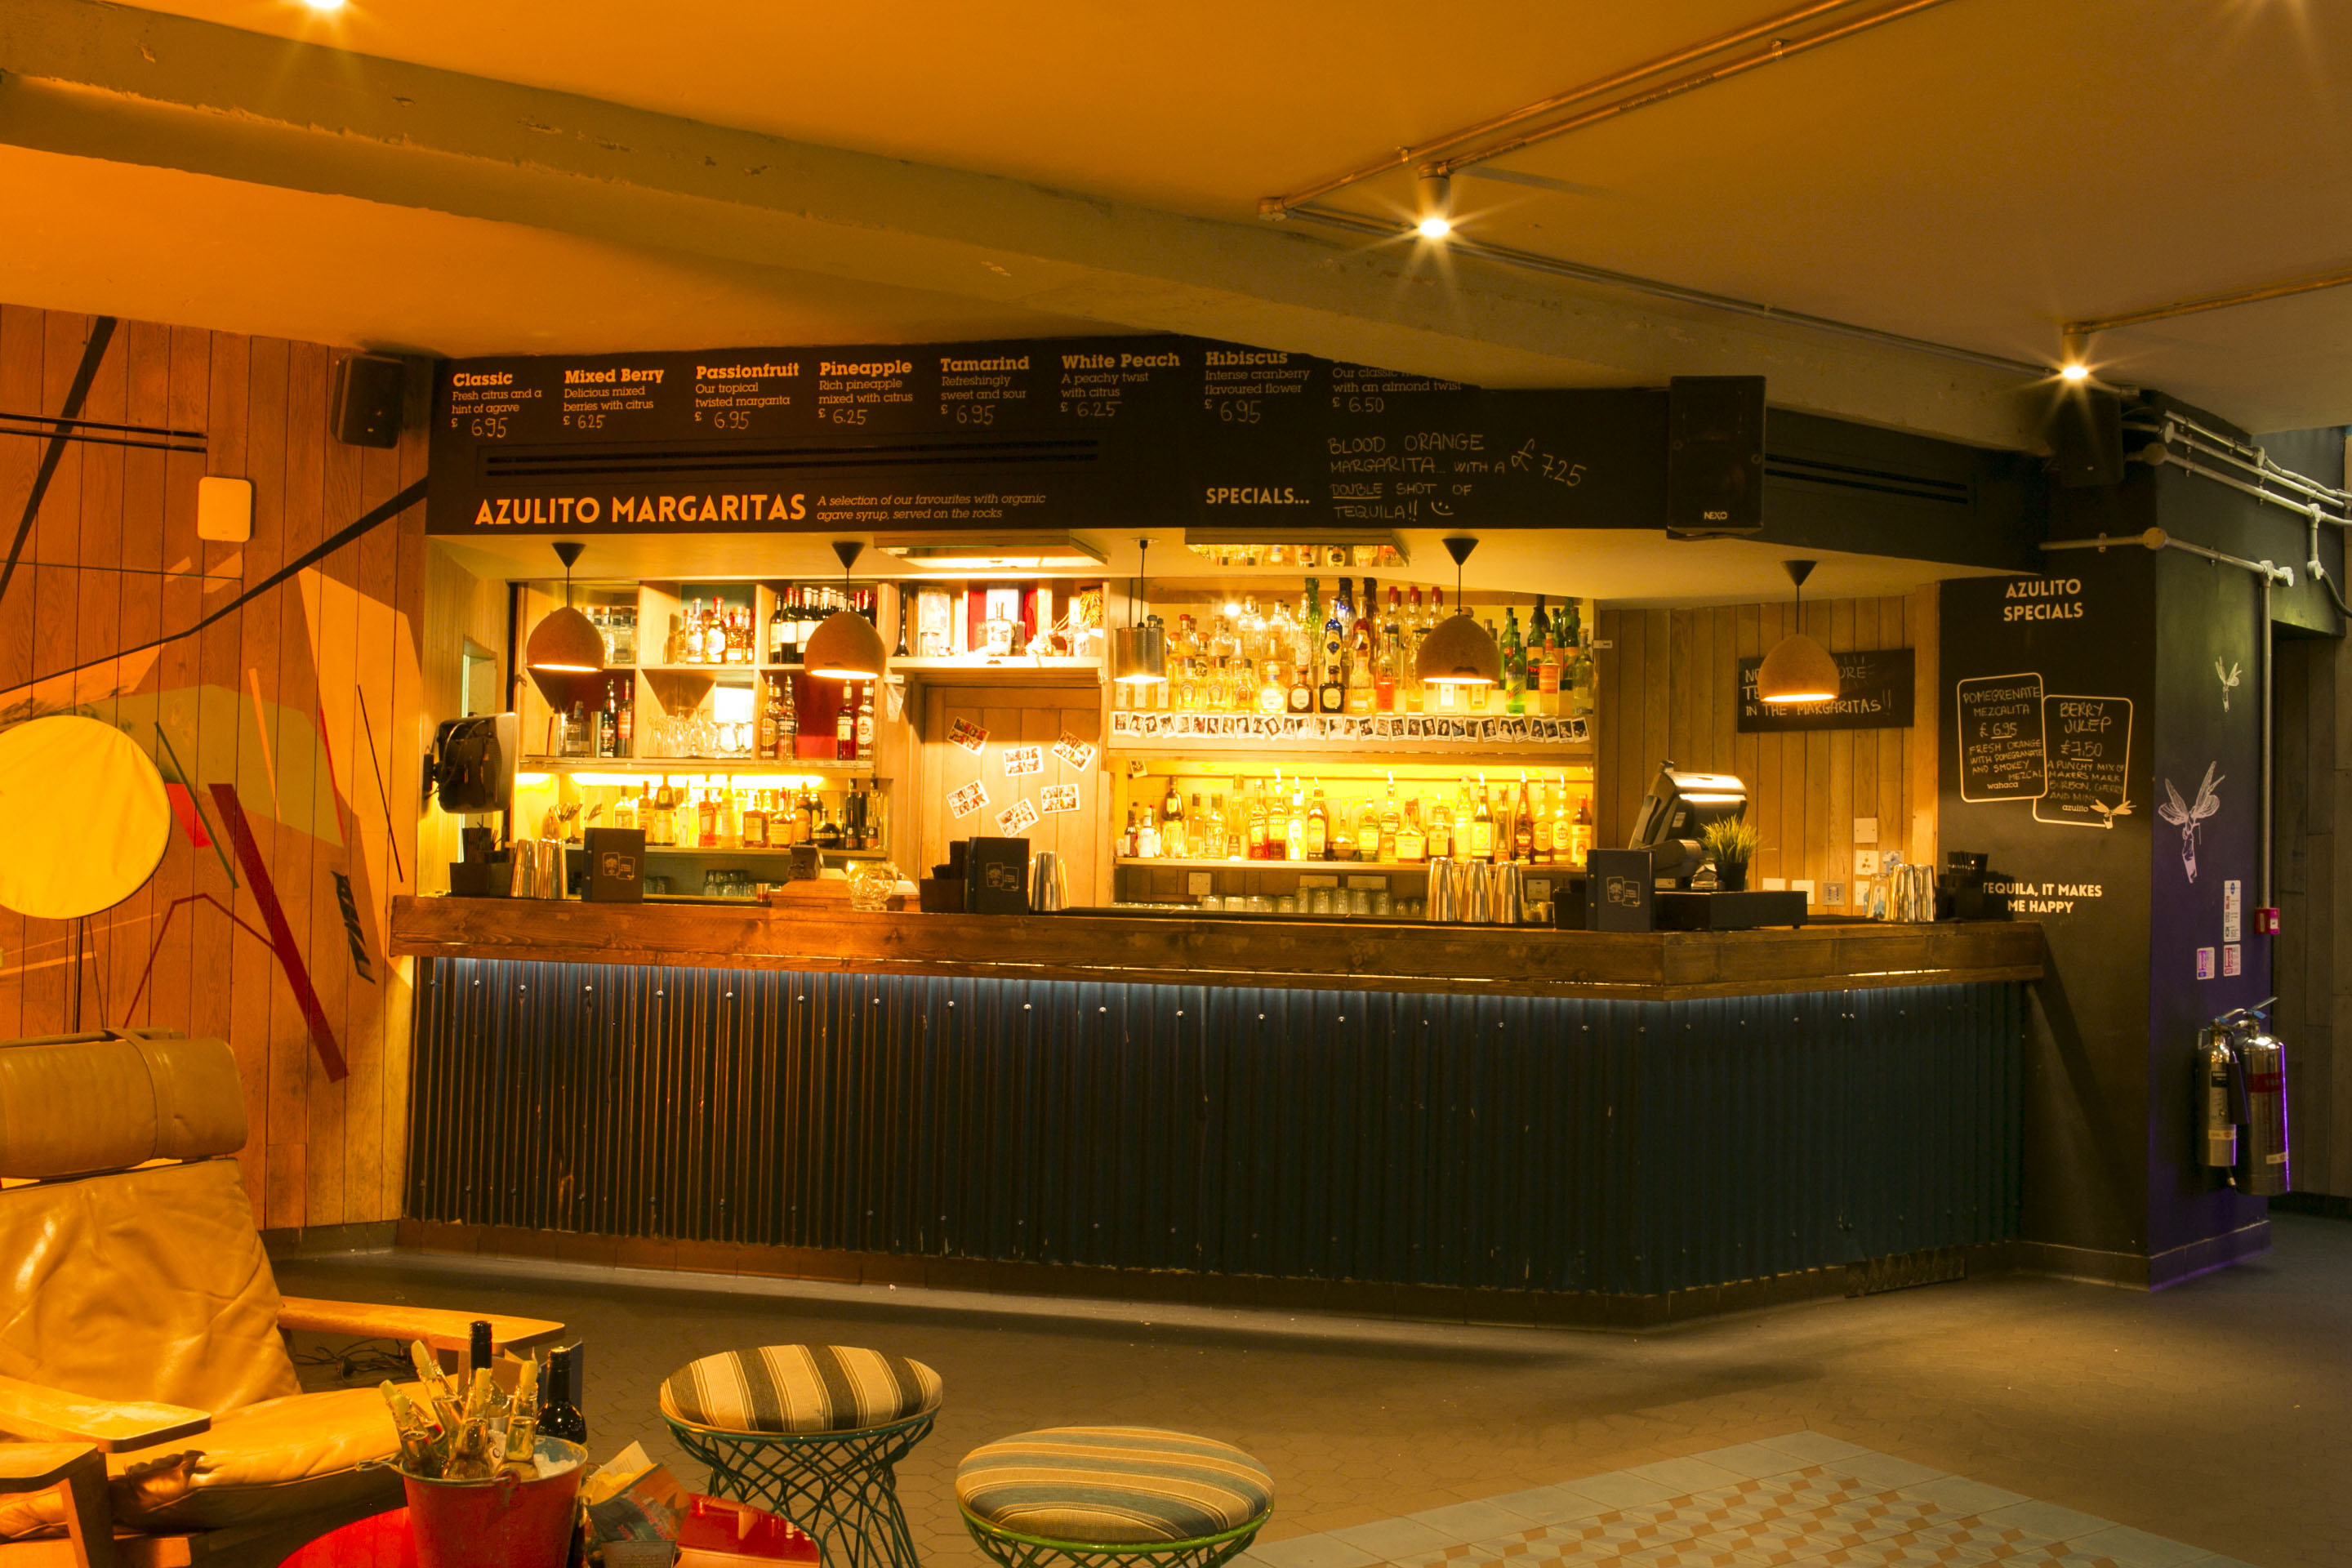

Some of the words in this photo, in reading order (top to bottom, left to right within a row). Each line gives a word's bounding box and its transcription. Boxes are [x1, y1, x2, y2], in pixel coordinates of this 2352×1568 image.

[941, 356, 1029, 372] Tamarind
[1062, 354, 1115, 368] White
[1120, 353, 1181, 368] Peach
[1205, 351, 1288, 366] Hibiscus
[696, 363, 799, 380] Passionfruit
[820, 360, 912, 378] Pineapple
[1205, 370, 1249, 381] Intense
[1250, 368, 1310, 381] cranberry
[1333, 368, 1356, 379] Our
[452, 372, 513, 387] Classic
[564, 369, 616, 384] Mixed
[621, 369, 664, 384] Berry
[942, 374, 1010, 388] Refreshingly
[1062, 374, 1071, 384] A
[1074, 373, 1119, 386] peachy
[1121, 372, 1149, 382] twist
[696, 383, 715, 394] Our
[719, 381, 758, 394] tropical
[819, 379, 843, 390] Rich
[846, 377, 902, 391] pineapple
[1205, 384, 1262, 395] flavoured
[1265, 382, 1302, 394] flower
[1333, 382, 1359, 393] with
[1362, 384, 1379, 393] an
[1382, 381, 1430, 392] almond
[452, 391, 479, 401] Fresh
[481, 390, 509, 399] citrus
[511, 389, 532, 399] and
[534, 390, 541, 399] a
[564, 387, 609, 399] Delicious
[612, 386, 645, 396] mixed
[819, 393, 853, 403] mixed
[857, 392, 881, 403] with
[884, 390, 912, 402] citrus
[941, 390, 973, 400] sweet
[976, 388, 1000, 399] and
[1003, 390, 1027, 399] sour
[1061, 388, 1085, 398] with
[1088, 387, 1120, 397] citrus
[564, 401, 599, 412] berries
[601, 400, 623, 410] with
[626, 399, 653, 409] citrus
[696, 396, 733, 408] twisted
[737, 395, 790, 408] margarita
[452, 403, 471, 414] hint
[474, 403, 484, 413] of
[486, 404, 519, 415] agave
[1328, 436, 1385, 455] BLOOD
[1405, 432, 1485, 451] ORANGE
[1454, 461, 1488, 474] WITH
[1494, 461, 1505, 474] A
[1330, 483, 1383, 496] DOUBLE
[1396, 483, 1437, 495] SHOT
[1452, 483, 1472, 496] OF
[817, 496, 826, 506] A
[829, 494, 878, 506] selection
[880, 494, 893, 506] of
[895, 496, 913, 506] our
[915, 494, 970, 506] favourites
[973, 493, 999, 505] with
[1001, 493, 1046, 506] organic
[1206, 488, 1310, 505] SPECIALS...
[474, 497, 600, 525] AZULITO
[612, 493, 806, 523] MARGARITAS
[817, 510, 853, 522] agave
[856, 510, 890, 521] syrup,
[893, 508, 931, 519] served
[933, 510, 949, 519] on
[951, 508, 969, 519] the
[972, 507, 1002, 519] rocks
[1333, 500, 1418, 522] TEQUILA!!
[1704, 511, 1728, 520] NEXO
[2006, 578, 2082, 599] AZULITO
[2003, 602, 2083, 621] SPECIALS
[1746, 706, 1757, 717] IN
[1763, 703, 1787, 717] THE
[1974, 705, 2029, 717] MEZCALITA
[2060, 702, 2103, 717] BERRY
[2065, 716, 2111, 733] JULEP
[1969, 743, 2001, 755] FRESH
[2007, 739, 2042, 750] ORANGE
[1970, 755, 1992, 764] WITH
[2047, 760, 2054, 769] A
[2056, 760, 2092, 772] PUNCHY
[2097, 764, 2115, 772] MIX
[1973, 763, 1989, 775] AND
[1993, 760, 2029, 773] SMOKEY
[2008, 769, 2043, 782] MEZCAL
[2091, 773, 2120, 782] MARK
[1987, 782, 2018, 790] wahaca
[2049, 791, 2070, 800] AND
[2062, 804, 2088, 813] azulito
[2042, 883, 2055, 896] IT
[2058, 884, 2103, 898] MAKES
[2007, 899, 2025, 912] ME
[2029, 900, 2074, 913] HAPPY
